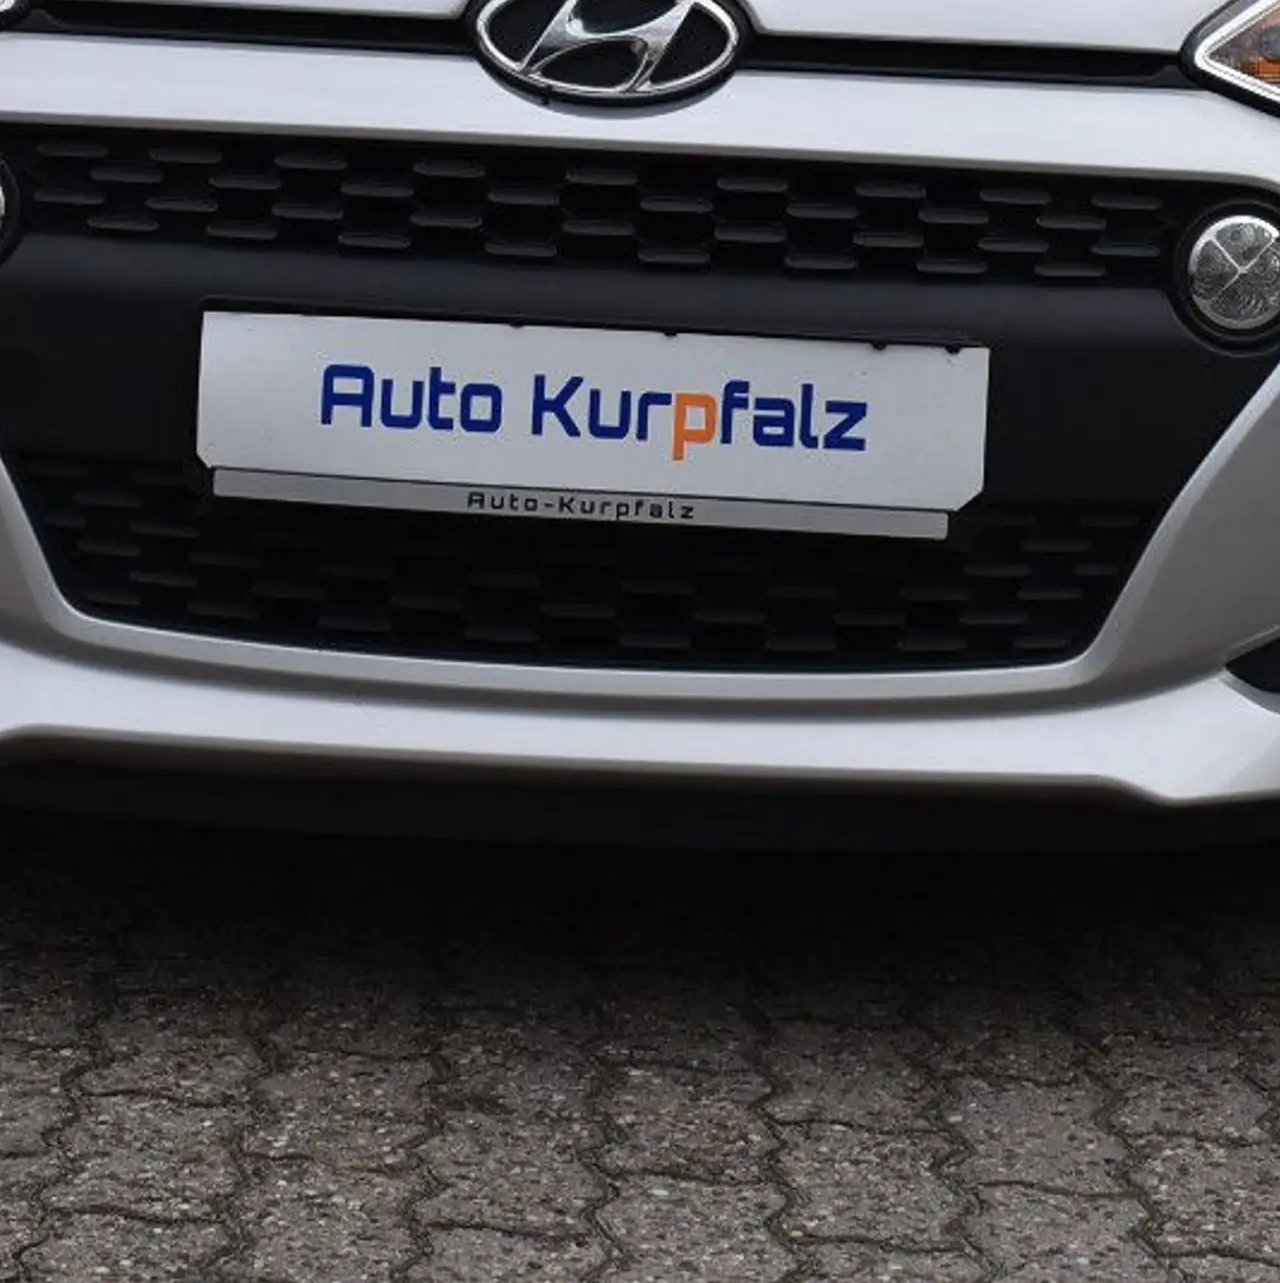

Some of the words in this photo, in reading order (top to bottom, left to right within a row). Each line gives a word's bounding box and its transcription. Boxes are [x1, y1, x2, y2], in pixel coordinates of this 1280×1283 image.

[320, 364, 503, 433] Auto
[531, 374, 868, 461] Kurpfalz
[466, 491, 695, 521] Auto-Kurpfalz
